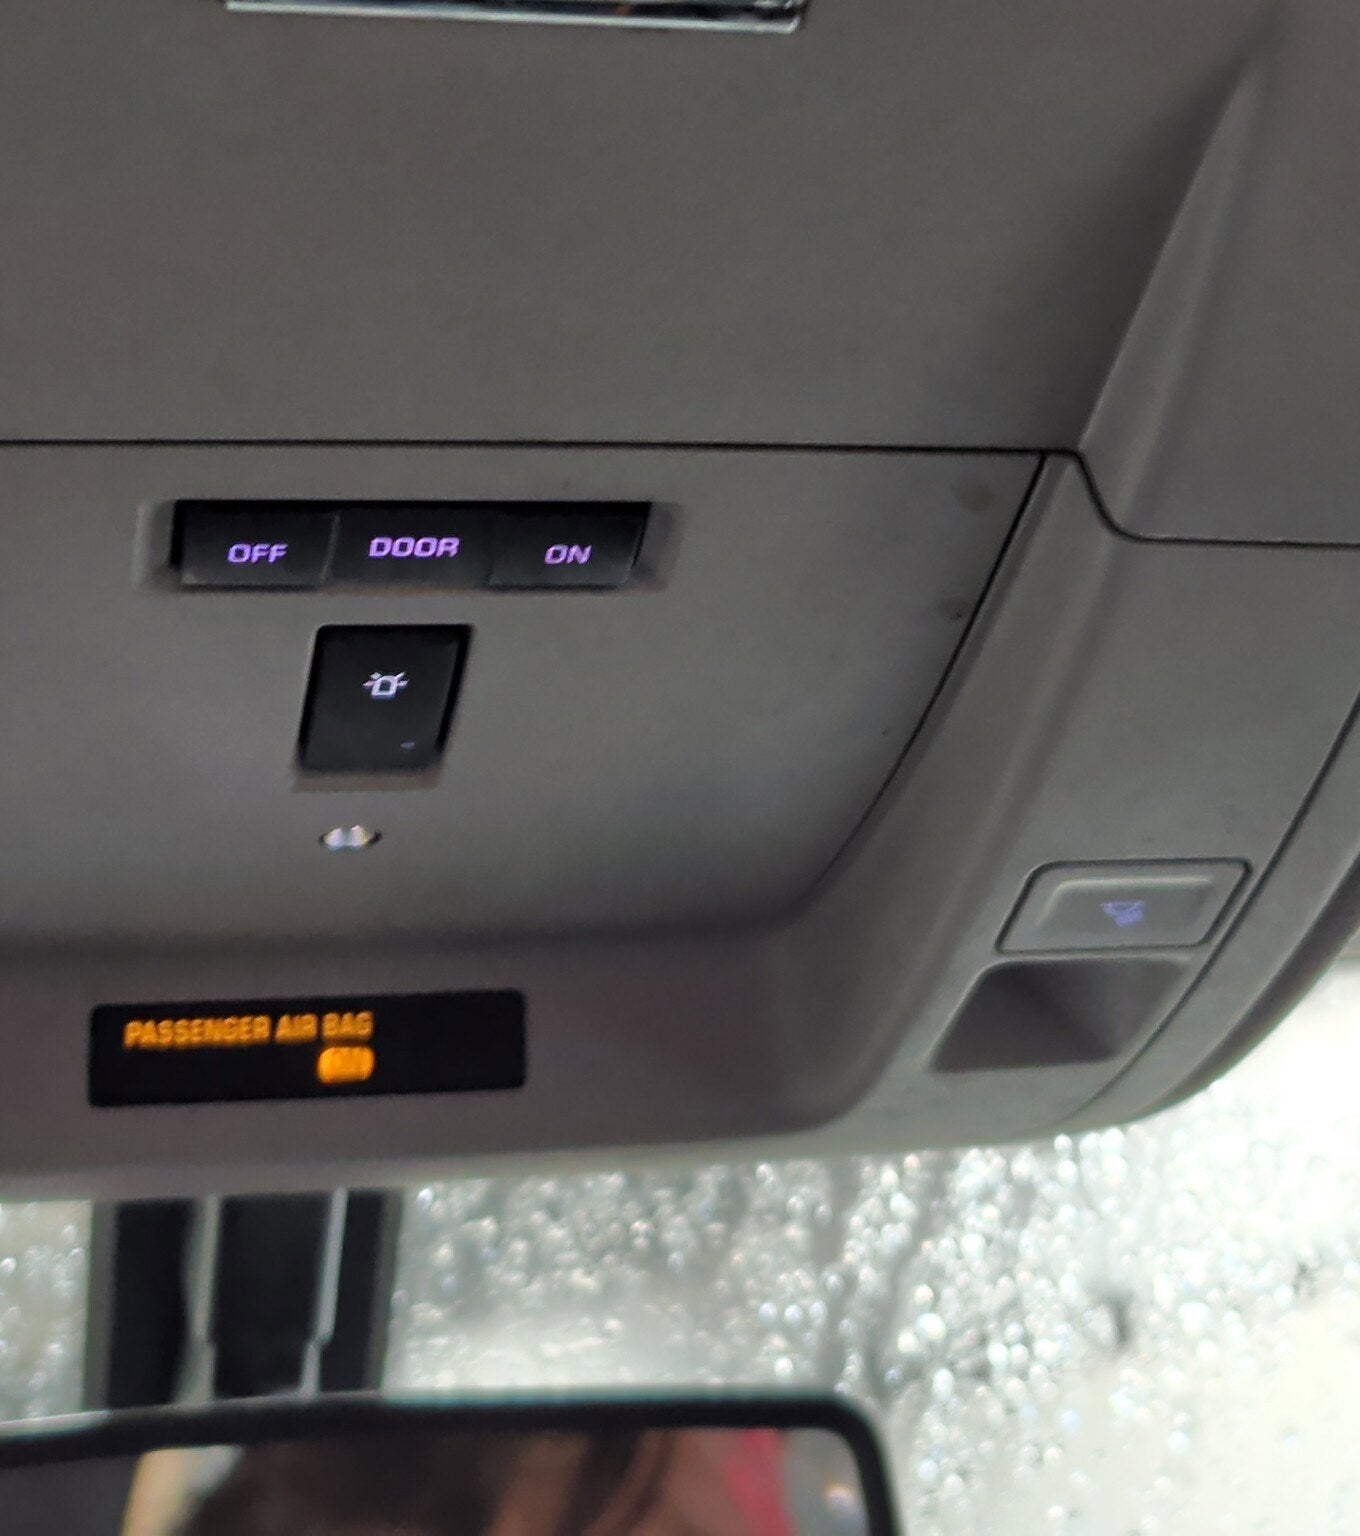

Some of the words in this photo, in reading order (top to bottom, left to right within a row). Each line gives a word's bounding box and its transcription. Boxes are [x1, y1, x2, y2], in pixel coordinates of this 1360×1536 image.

[226, 542, 289, 565] OFF
[367, 536, 461, 559] DOOR
[544, 544, 592, 566] ON
[123, 1016, 272, 1050] PASSENGER
[274, 1013, 319, 1044] AIR
[321, 1011, 375, 1043] BAG
